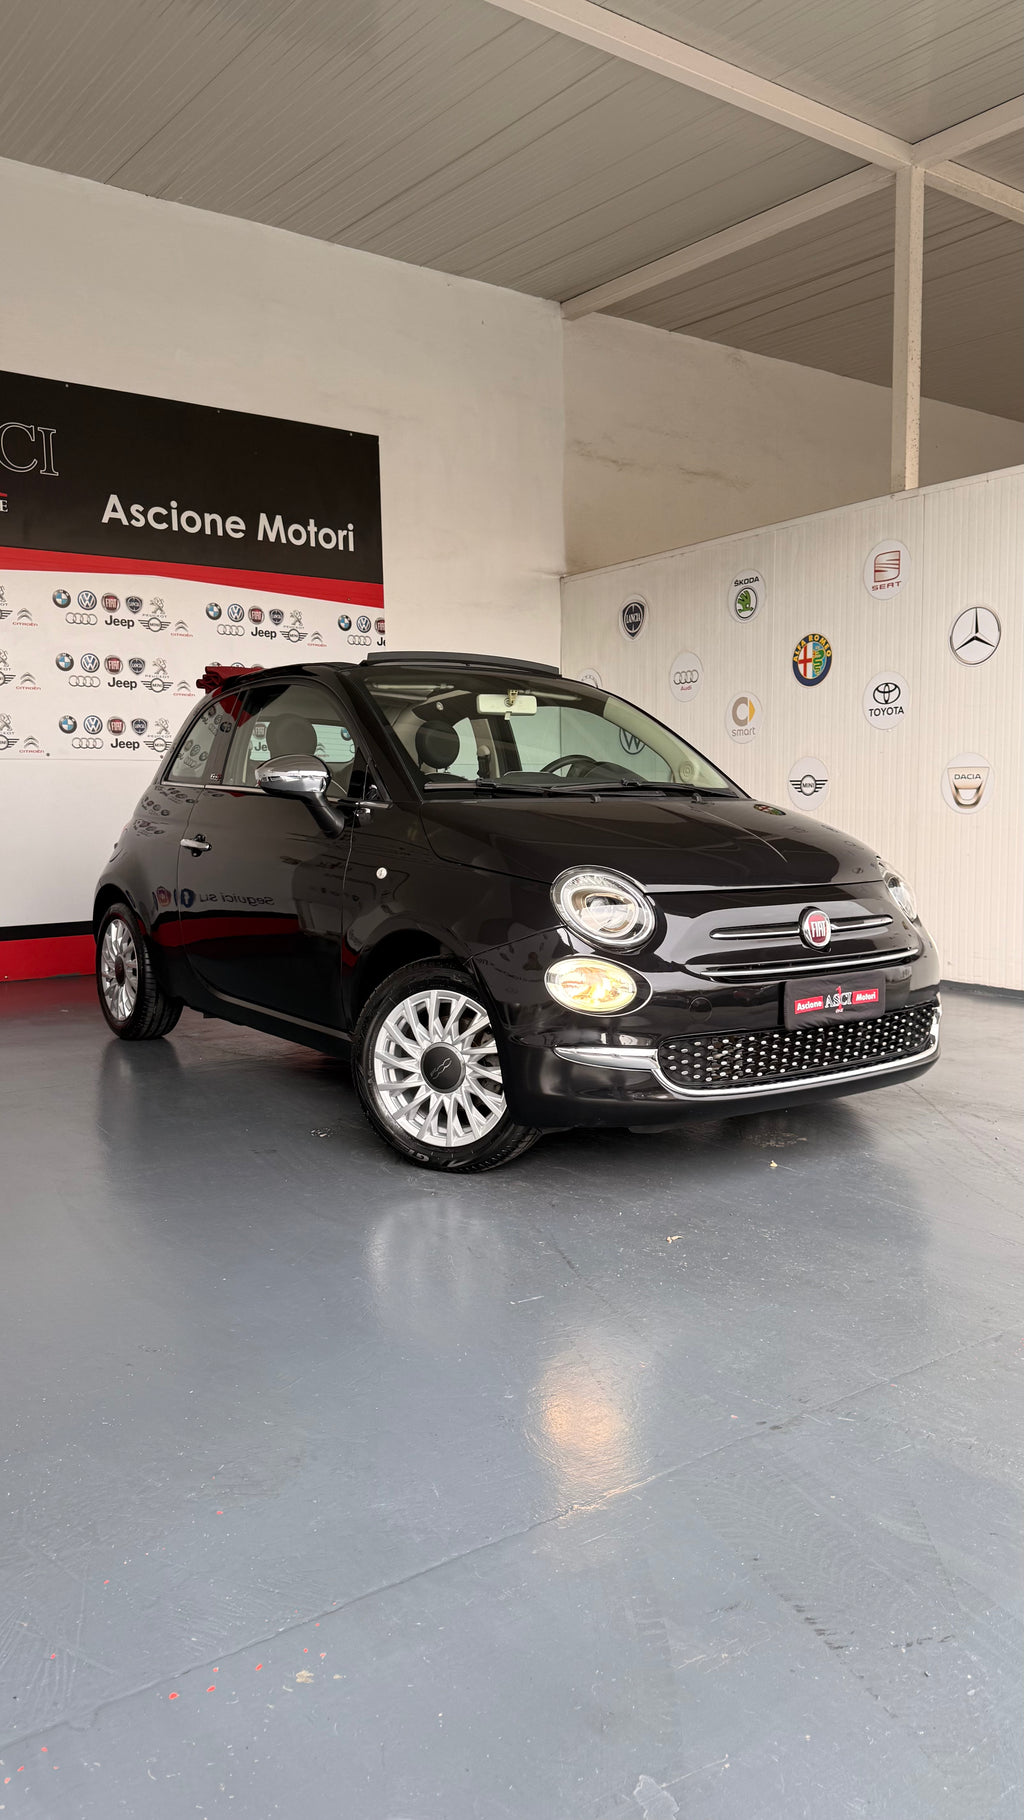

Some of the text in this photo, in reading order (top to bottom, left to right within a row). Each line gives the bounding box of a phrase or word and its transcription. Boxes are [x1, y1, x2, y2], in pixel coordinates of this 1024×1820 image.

[101, 494, 354, 552] Ascione Motori
[871, 580, 902, 591] SEAT
[105, 615, 134, 629] Jeep
[251, 626, 277, 640] Jeep
[792, 634, 832, 662] ALFA ROMEO
[107, 676, 137, 690] Jeep
[869, 706, 904, 717] TOYOTA
[731, 727, 756, 737] smart
[110, 738, 140, 751] Jeep
[811, 920, 826, 938] FIAT
[796, 1000, 822, 1011] Ascione
[856, 991, 876, 1002] Motori
